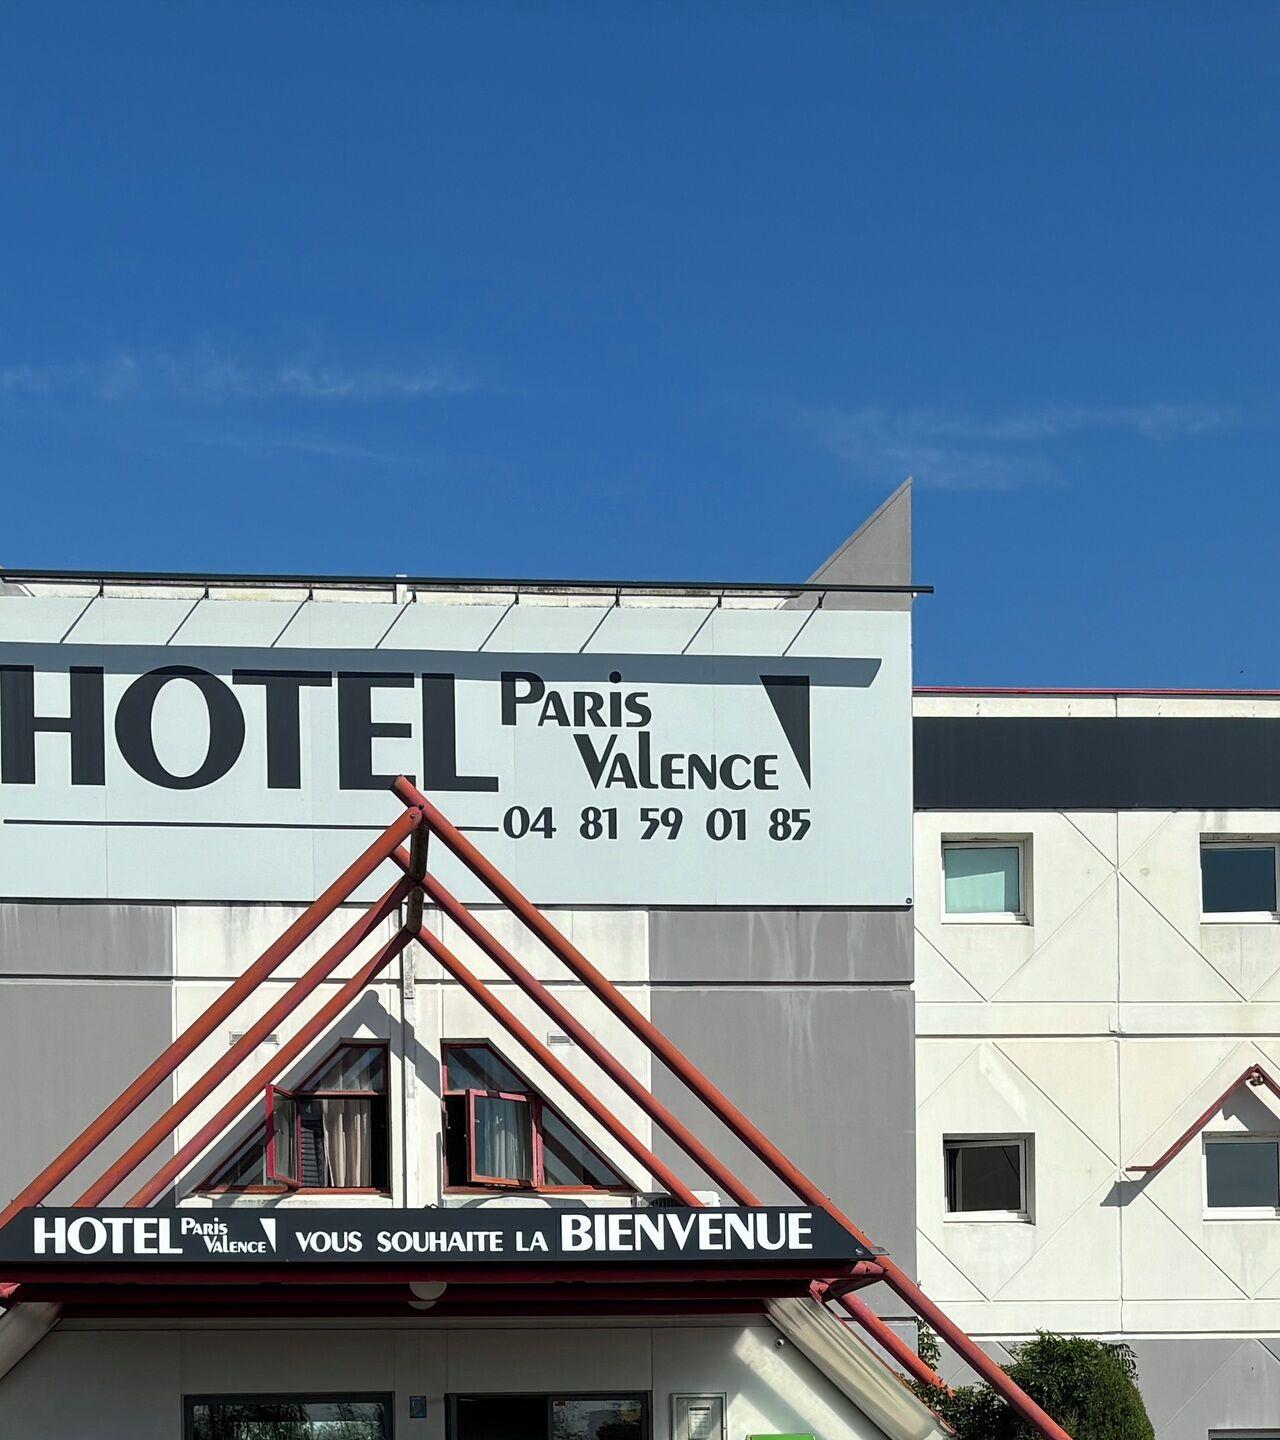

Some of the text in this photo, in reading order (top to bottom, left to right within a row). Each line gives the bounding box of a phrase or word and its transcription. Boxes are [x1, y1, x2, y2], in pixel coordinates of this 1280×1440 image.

[0, 664, 499, 791] HOTEL
[503, 805, 811, 841] 04 81 59 01 85
[33, 1216, 184, 1255] HOTEL
[295, 1213, 813, 1253] VOUS SOUHAITE LA BIENVENUE
